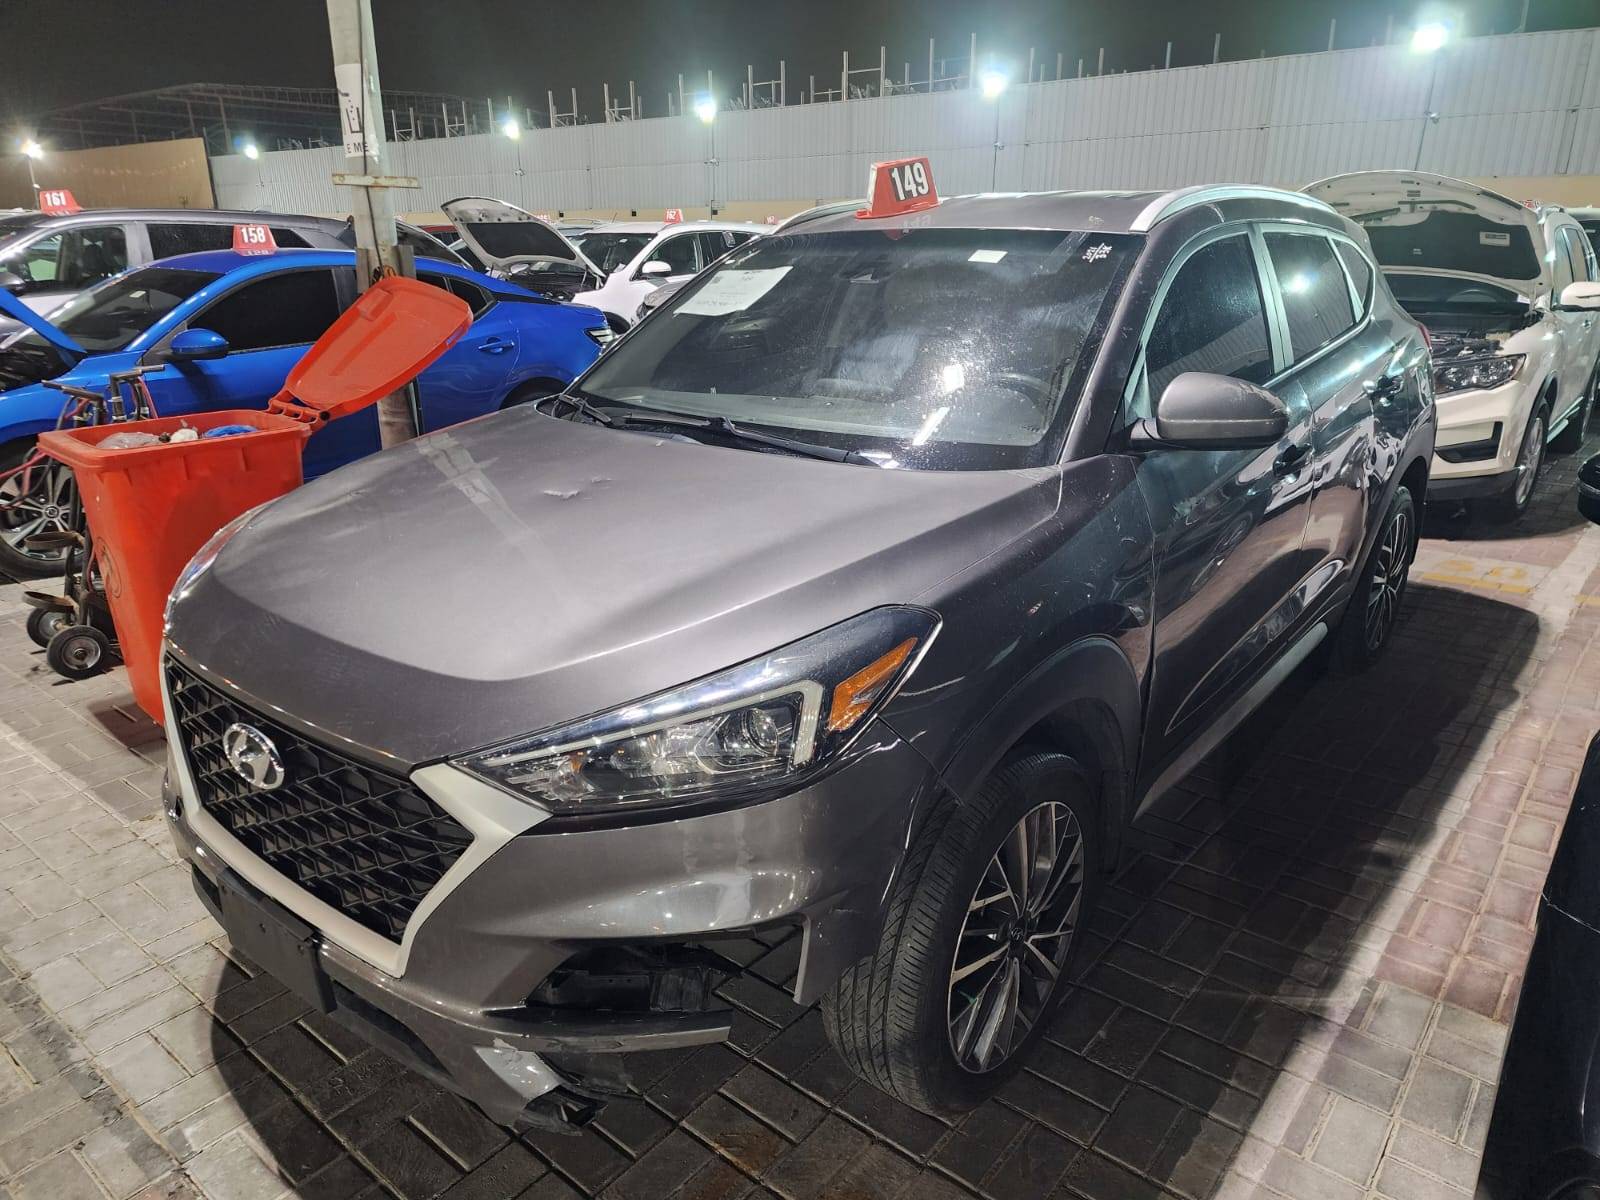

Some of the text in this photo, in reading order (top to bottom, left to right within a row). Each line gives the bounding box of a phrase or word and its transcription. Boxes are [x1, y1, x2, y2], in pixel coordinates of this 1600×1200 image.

[892, 162, 930, 201] 149
[45, 191, 67, 206] 161
[241, 226, 266, 243] 158
